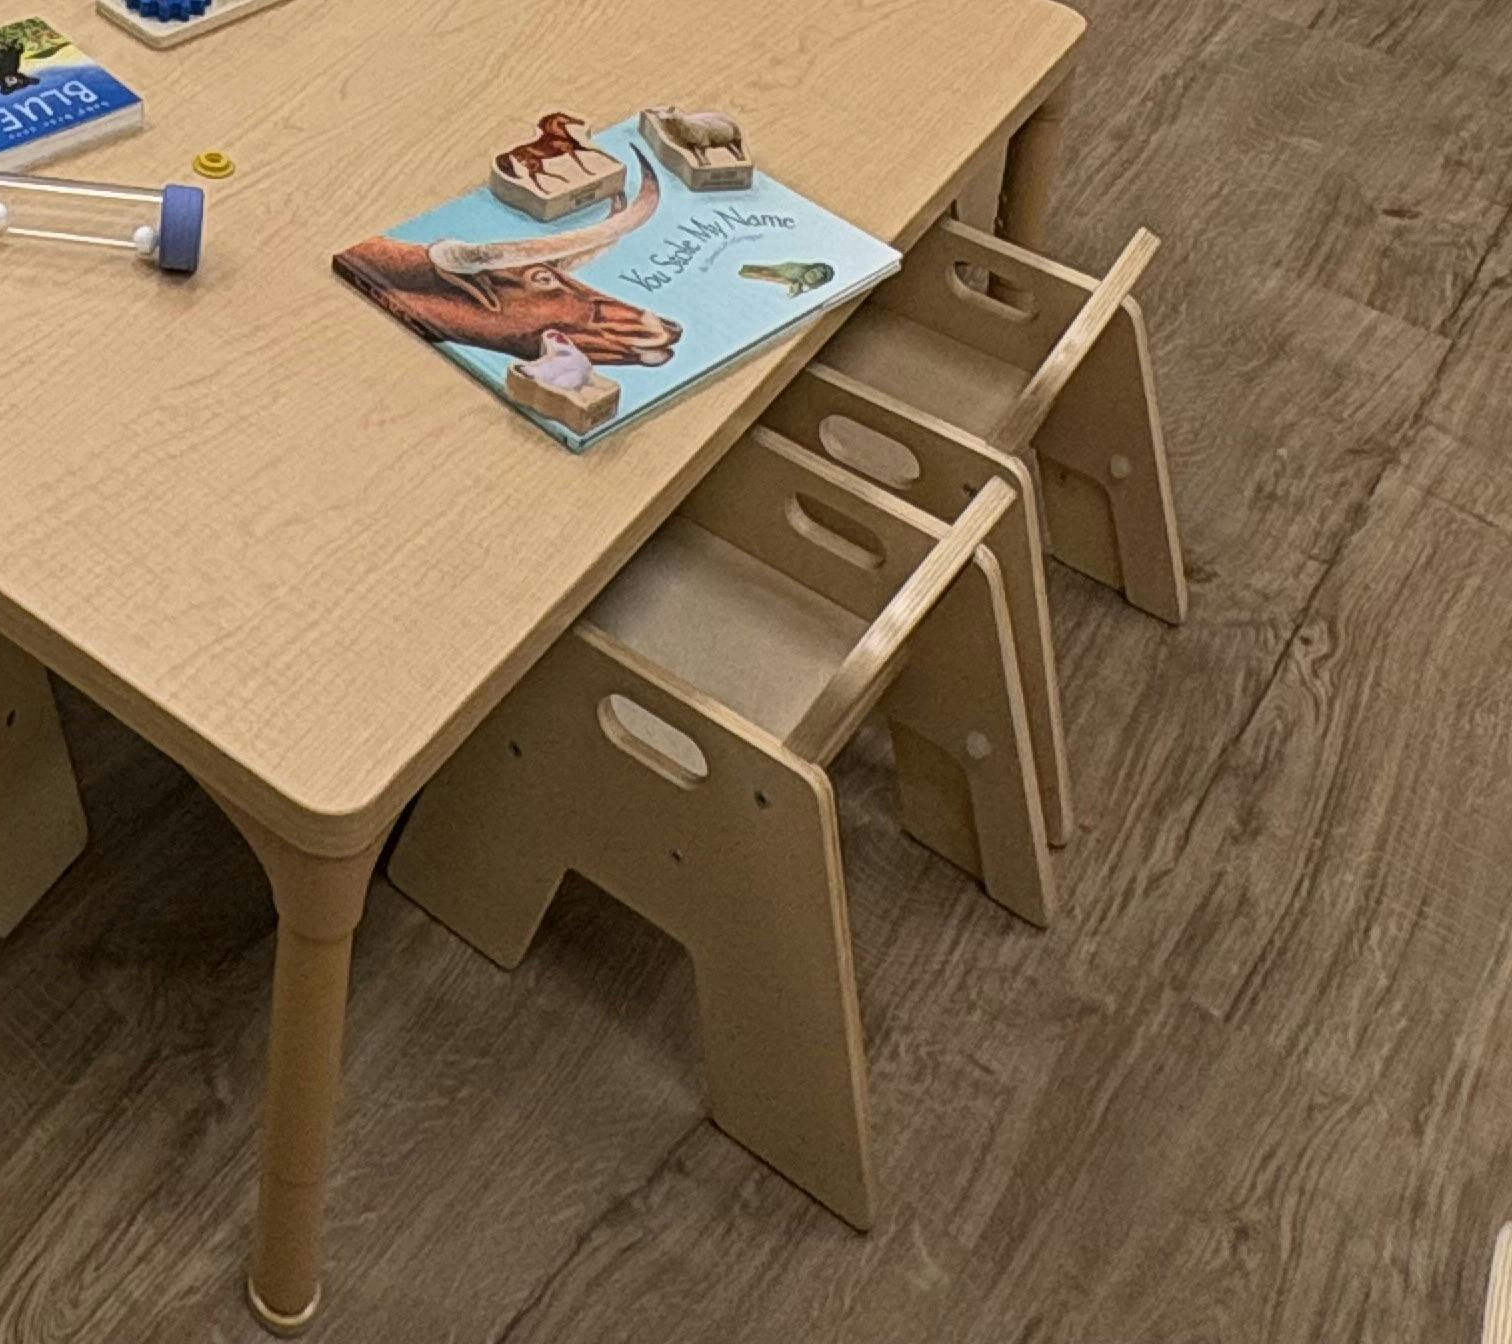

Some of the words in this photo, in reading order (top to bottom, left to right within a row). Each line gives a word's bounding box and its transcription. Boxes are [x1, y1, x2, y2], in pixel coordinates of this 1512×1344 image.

[618, 268, 672, 292] You
[677, 215, 728, 243] My
[713, 206, 796, 230] Name
